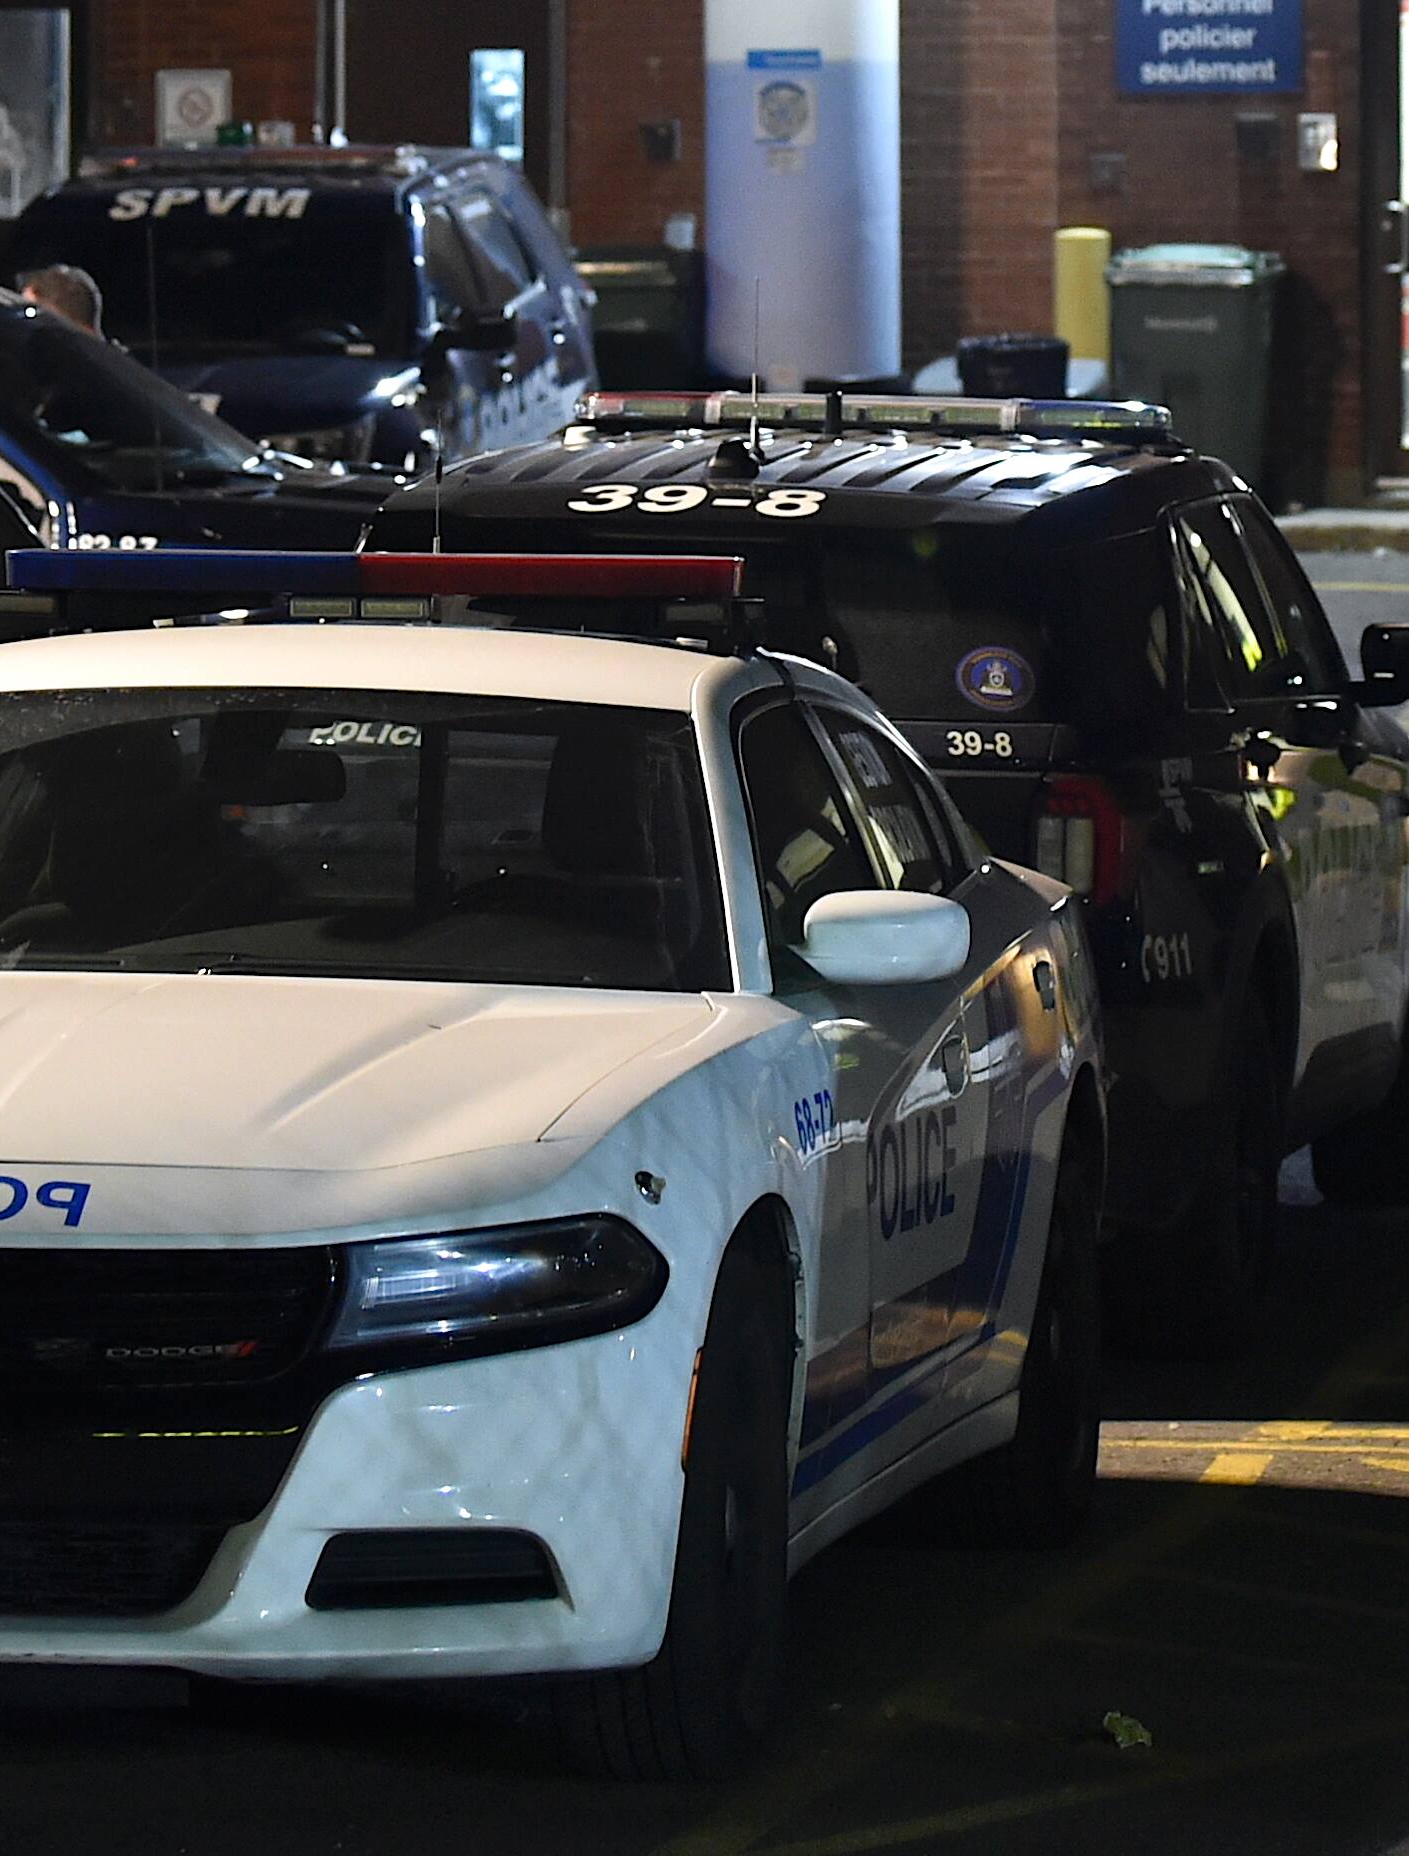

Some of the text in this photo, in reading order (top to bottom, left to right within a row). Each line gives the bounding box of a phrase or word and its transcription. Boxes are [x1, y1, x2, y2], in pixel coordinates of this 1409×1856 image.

[1158, 24, 1256, 54] policier
[1141, 59, 1276, 83] seulement
[109, 187, 311, 222] SPVM
[568, 484, 826, 518] 39-8
[946, 731, 1013, 757] 39-8
[866, 1105, 957, 1242] POLICE
